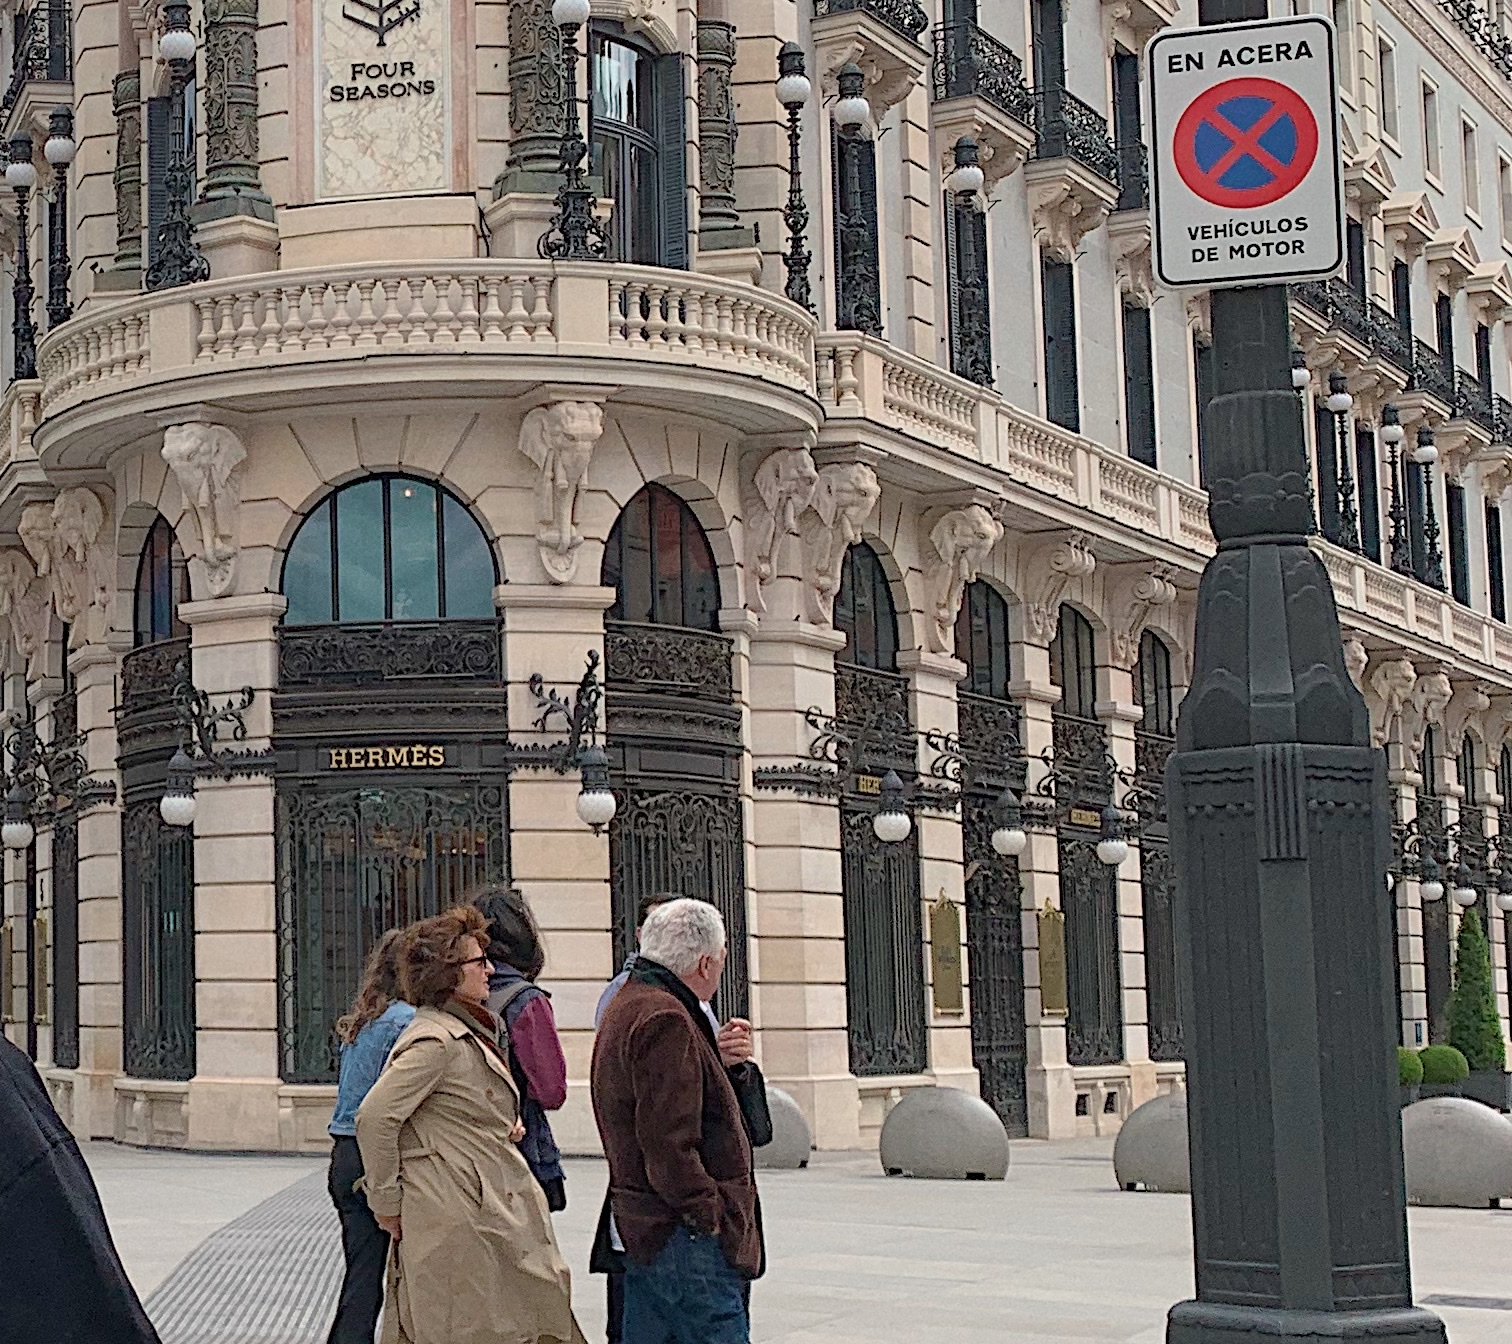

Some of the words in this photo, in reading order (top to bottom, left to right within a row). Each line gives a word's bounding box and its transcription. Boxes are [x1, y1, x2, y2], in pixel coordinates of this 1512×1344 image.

[1168, 52, 1204, 73] EN
[1217, 40, 1314, 68] ACERA
[350, 61, 416, 81] FOUR
[329, 79, 435, 102] SEASONS
[1188, 217, 1309, 240] VEHÍCULOS
[1191, 247, 1219, 263] DE
[1229, 239, 1305, 260] MOTOR
[858, 775, 883, 794] HER
